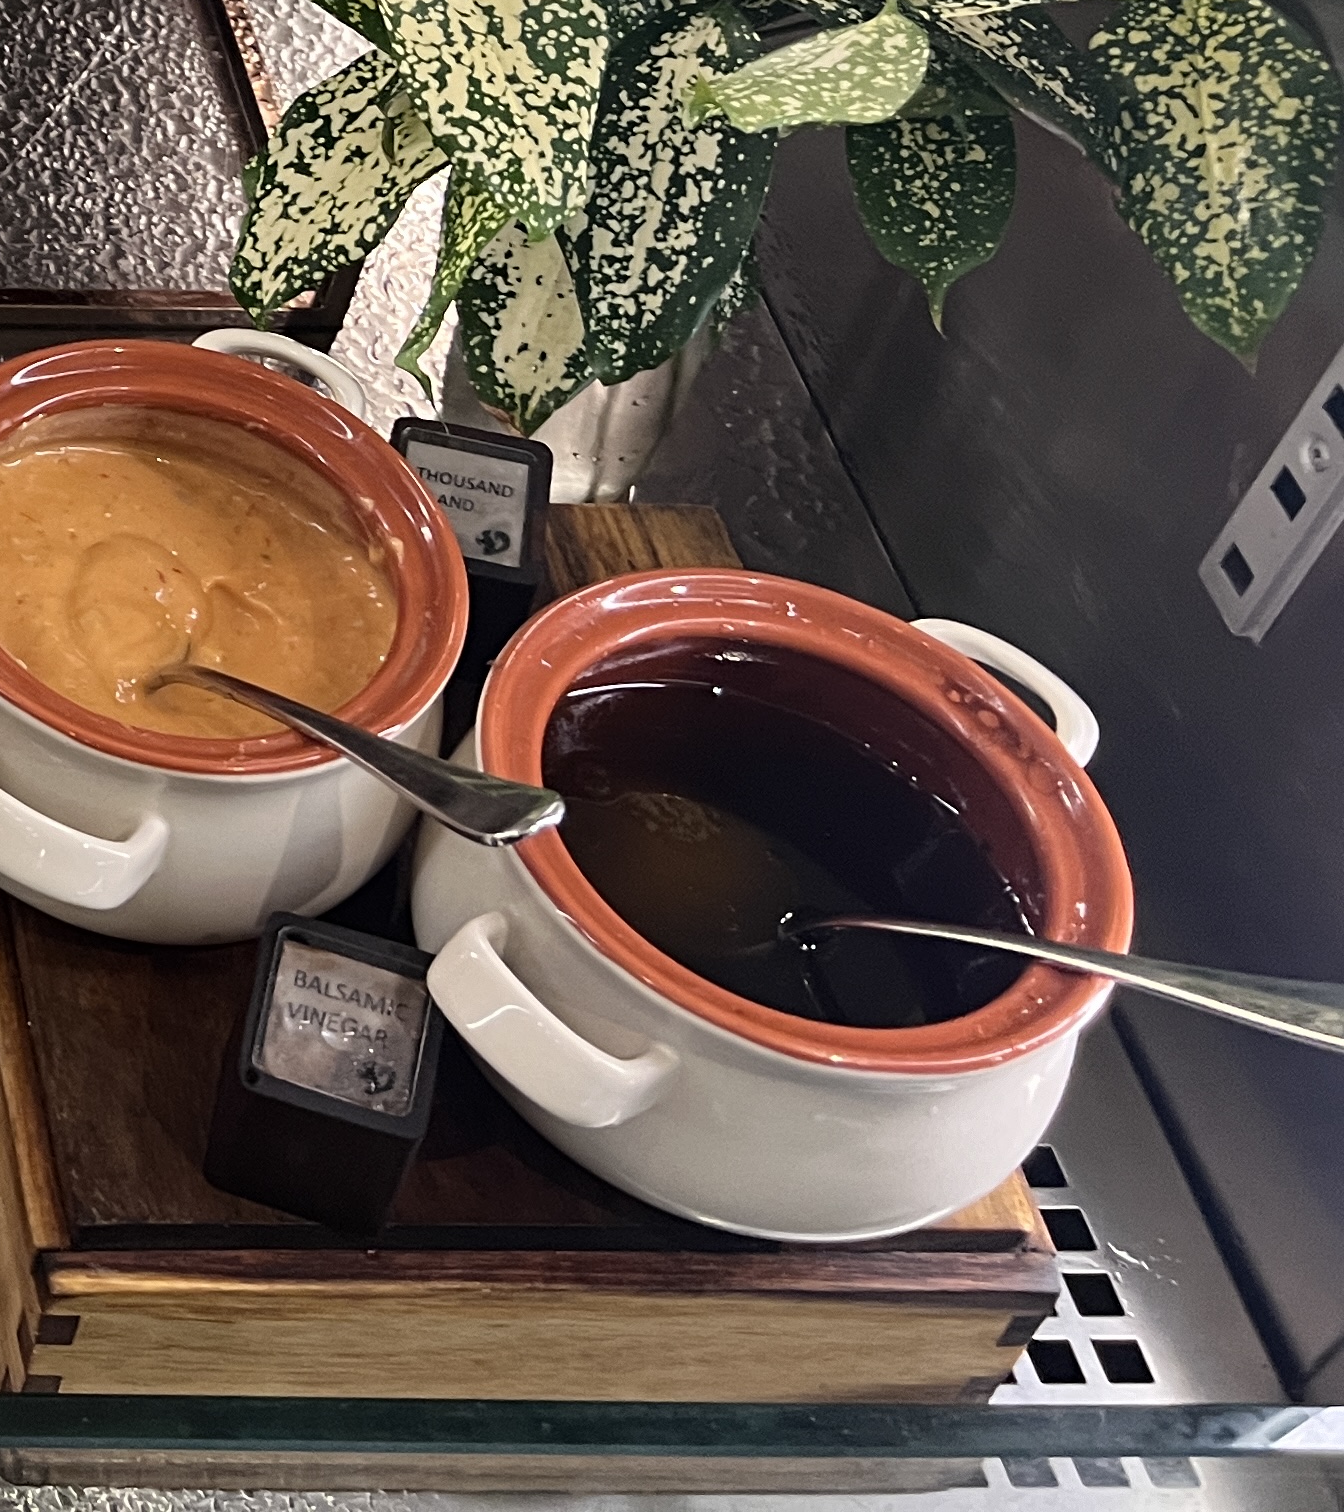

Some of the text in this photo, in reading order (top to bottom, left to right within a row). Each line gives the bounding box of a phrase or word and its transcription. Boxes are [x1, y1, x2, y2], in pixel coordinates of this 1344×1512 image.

[417, 466, 514, 498] THOUSAND
[437, 494, 475, 512] AND
[293, 969, 409, 1022] BALSAMIC
[287, 1002, 388, 1050] VINEGAR
